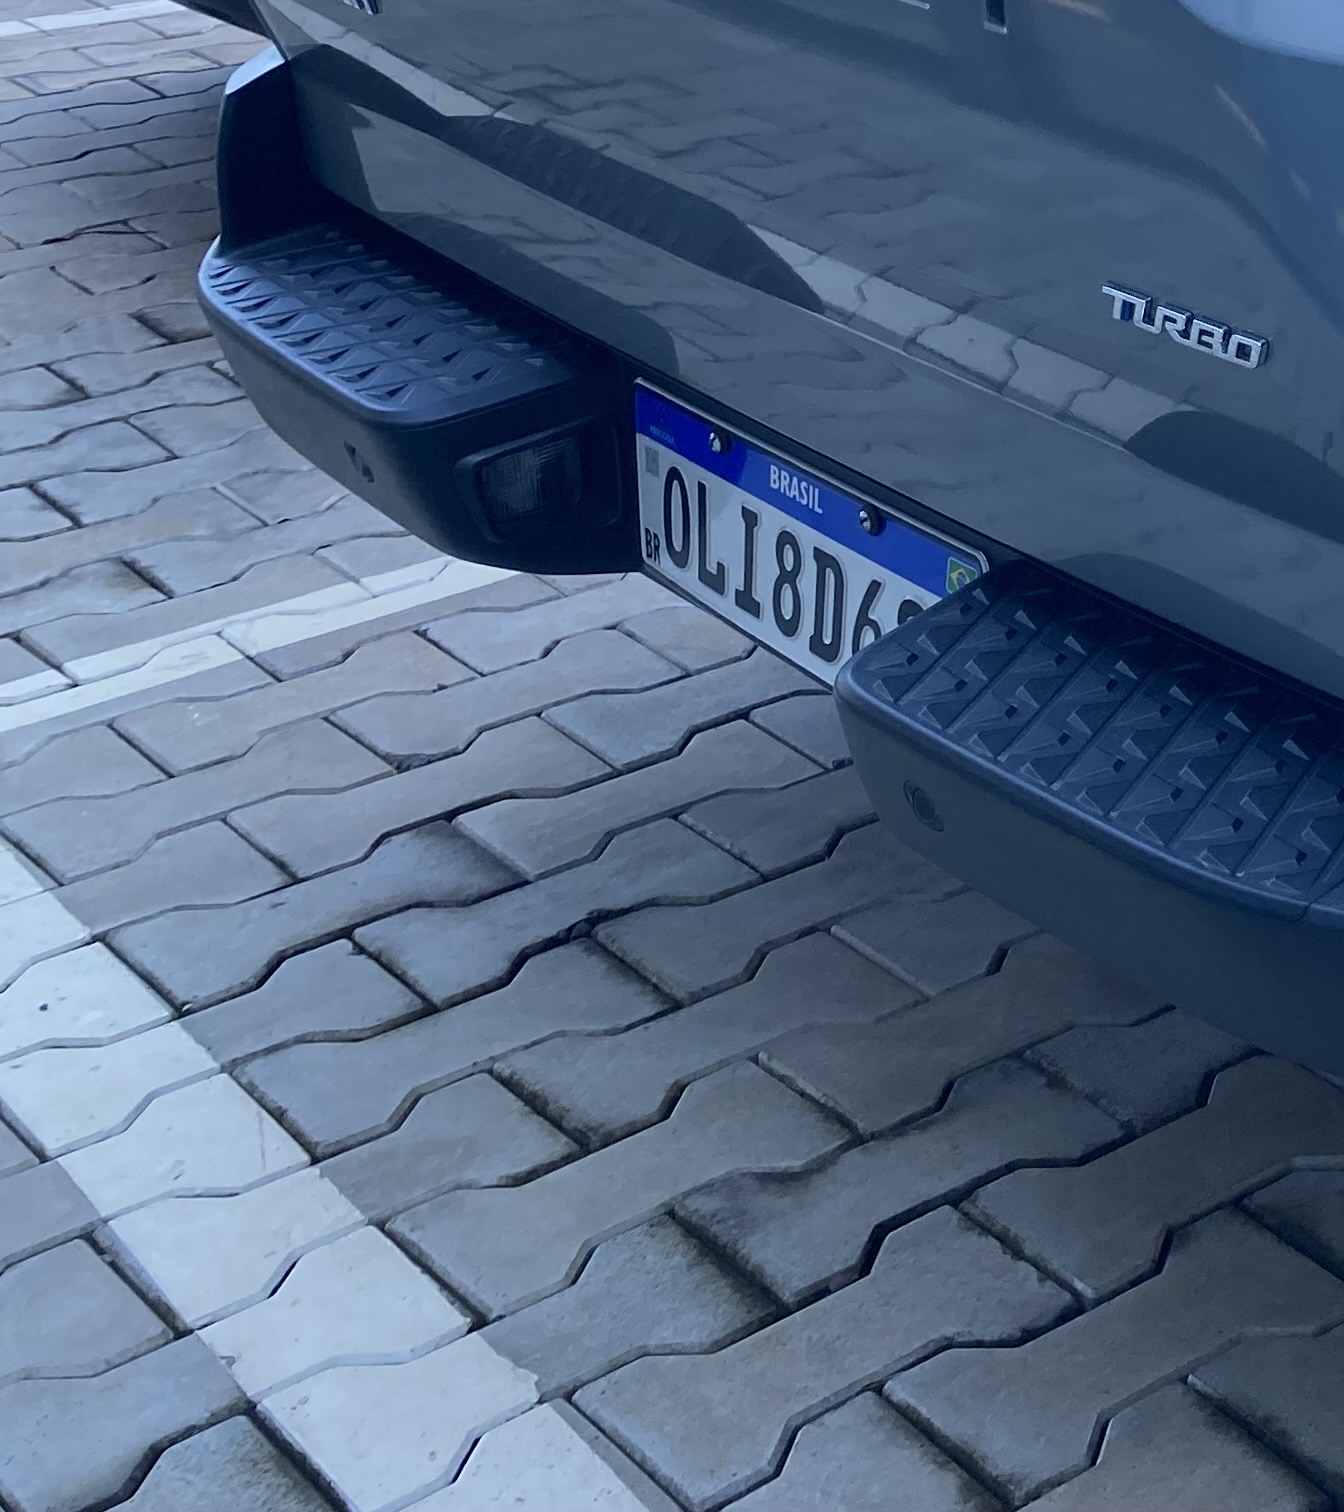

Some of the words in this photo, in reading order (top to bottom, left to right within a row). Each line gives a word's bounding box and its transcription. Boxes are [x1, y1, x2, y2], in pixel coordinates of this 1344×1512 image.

[1101, 280, 1269, 370] TURBO
[768, 464, 823, 515] BRASIL
[645, 527, 662, 566] BR
[662, 465, 926, 664] OLI8D6
